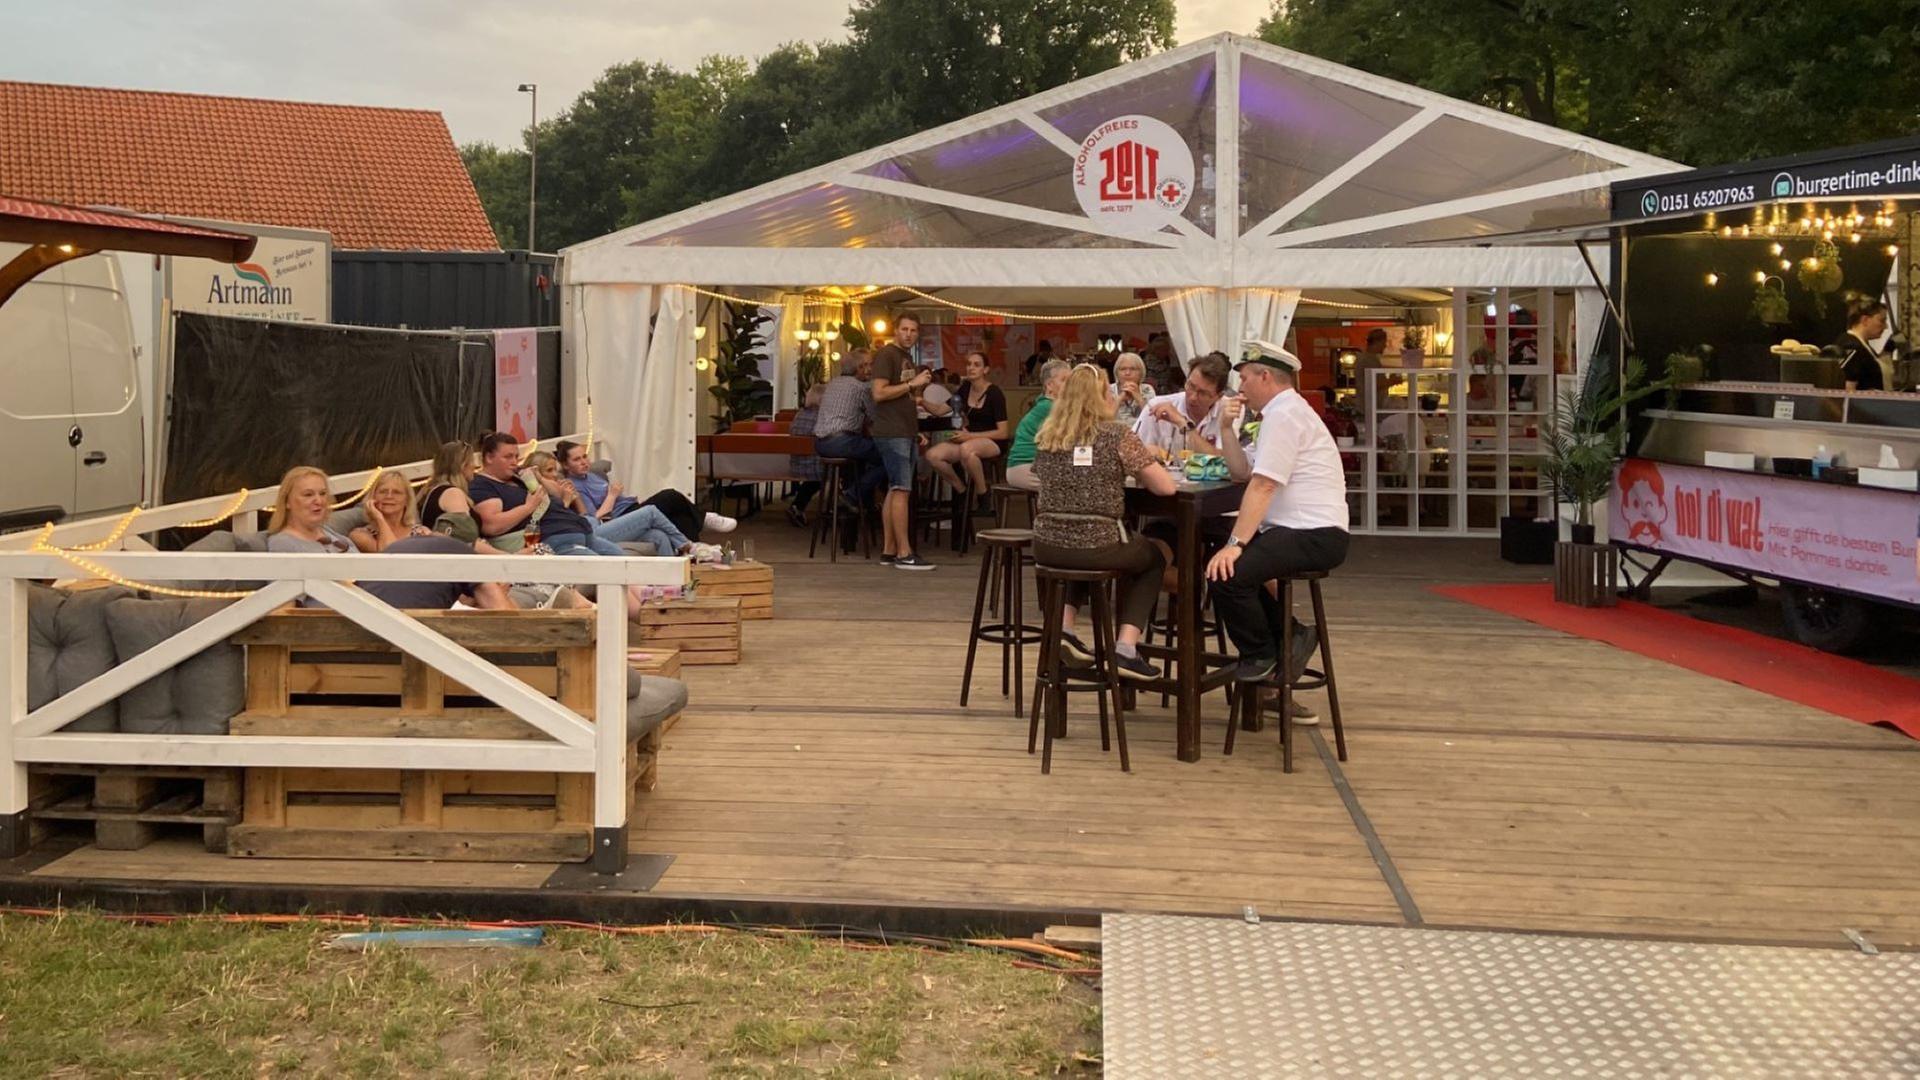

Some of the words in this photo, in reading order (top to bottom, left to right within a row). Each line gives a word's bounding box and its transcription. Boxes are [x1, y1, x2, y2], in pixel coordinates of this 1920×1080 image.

[1076, 120, 1139, 186] ALKOHOLFREIES
[1661, 194, 1688, 212] 0151
[1693, 186, 1754, 208] 65207963
[207, 275, 292, 304] Artmann
[1675, 485, 1701, 539] hol
[1707, 489, 1722, 543] di
[1726, 496, 1764, 552] wat
[1823, 531, 1839, 546] de
[1841, 536, 1887, 554] besten
[1791, 545, 1841, 568] Pommes
